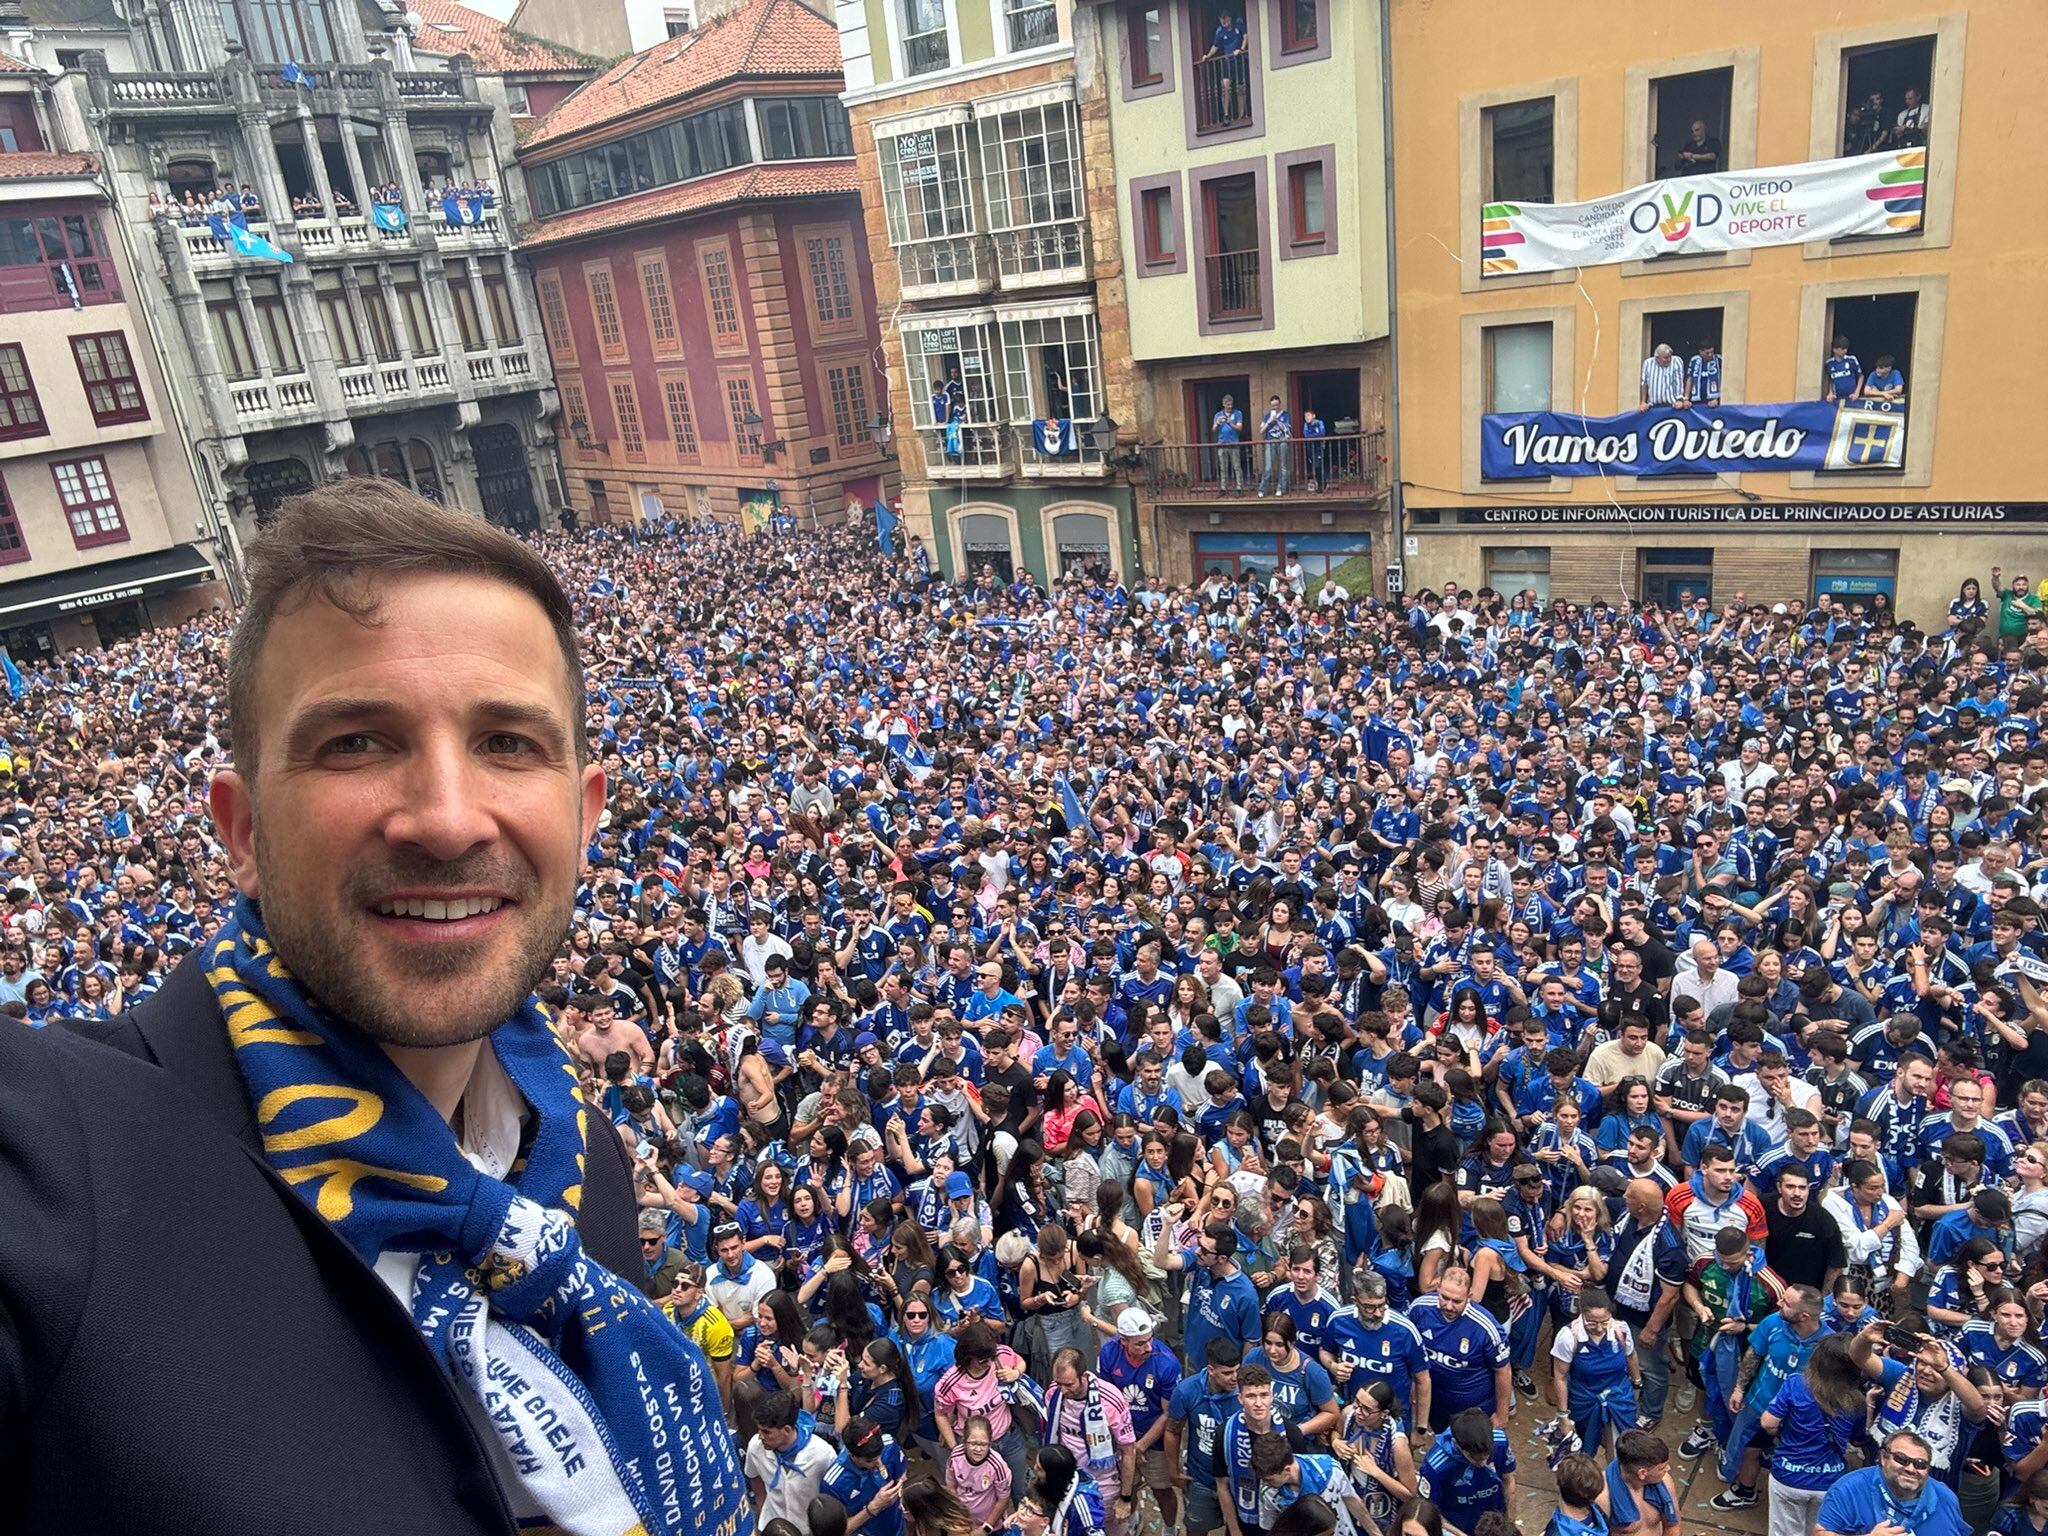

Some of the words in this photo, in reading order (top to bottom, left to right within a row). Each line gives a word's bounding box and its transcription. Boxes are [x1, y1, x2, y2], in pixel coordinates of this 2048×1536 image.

[1729, 179, 1793, 199] OVIEDO
[1578, 208, 1625, 223] CANDIDATA
[1592, 201, 1625, 213] OVIEDO
[1729, 199, 1765, 217] VIVE
[1769, 198, 1787, 213] EL
[1728, 214, 1807, 235] DEPORTE
[1502, 423, 1638, 466] Vamos
[1648, 417, 1806, 463] Oviedo
[1484, 509, 1538, 522] CENTRO
[1541, 508, 1559, 522] DE
[1750, 506, 1781, 520] DEL
[1784, 506, 1886, 520] PRINCIPADO
[1889, 506, 1913, 519] DE
[1916, 505, 2006, 519] ASTURIAS
[83, 592, 115, 606] CALLES
[1341, 1351, 1393, 1374] DIGI
[629, 1351, 668, 1449] COSTAS
[699, 1415, 718, 1464] DEL
[678, 1424, 704, 1508] NACHO
[655, 1451, 682, 1526] DAVID
